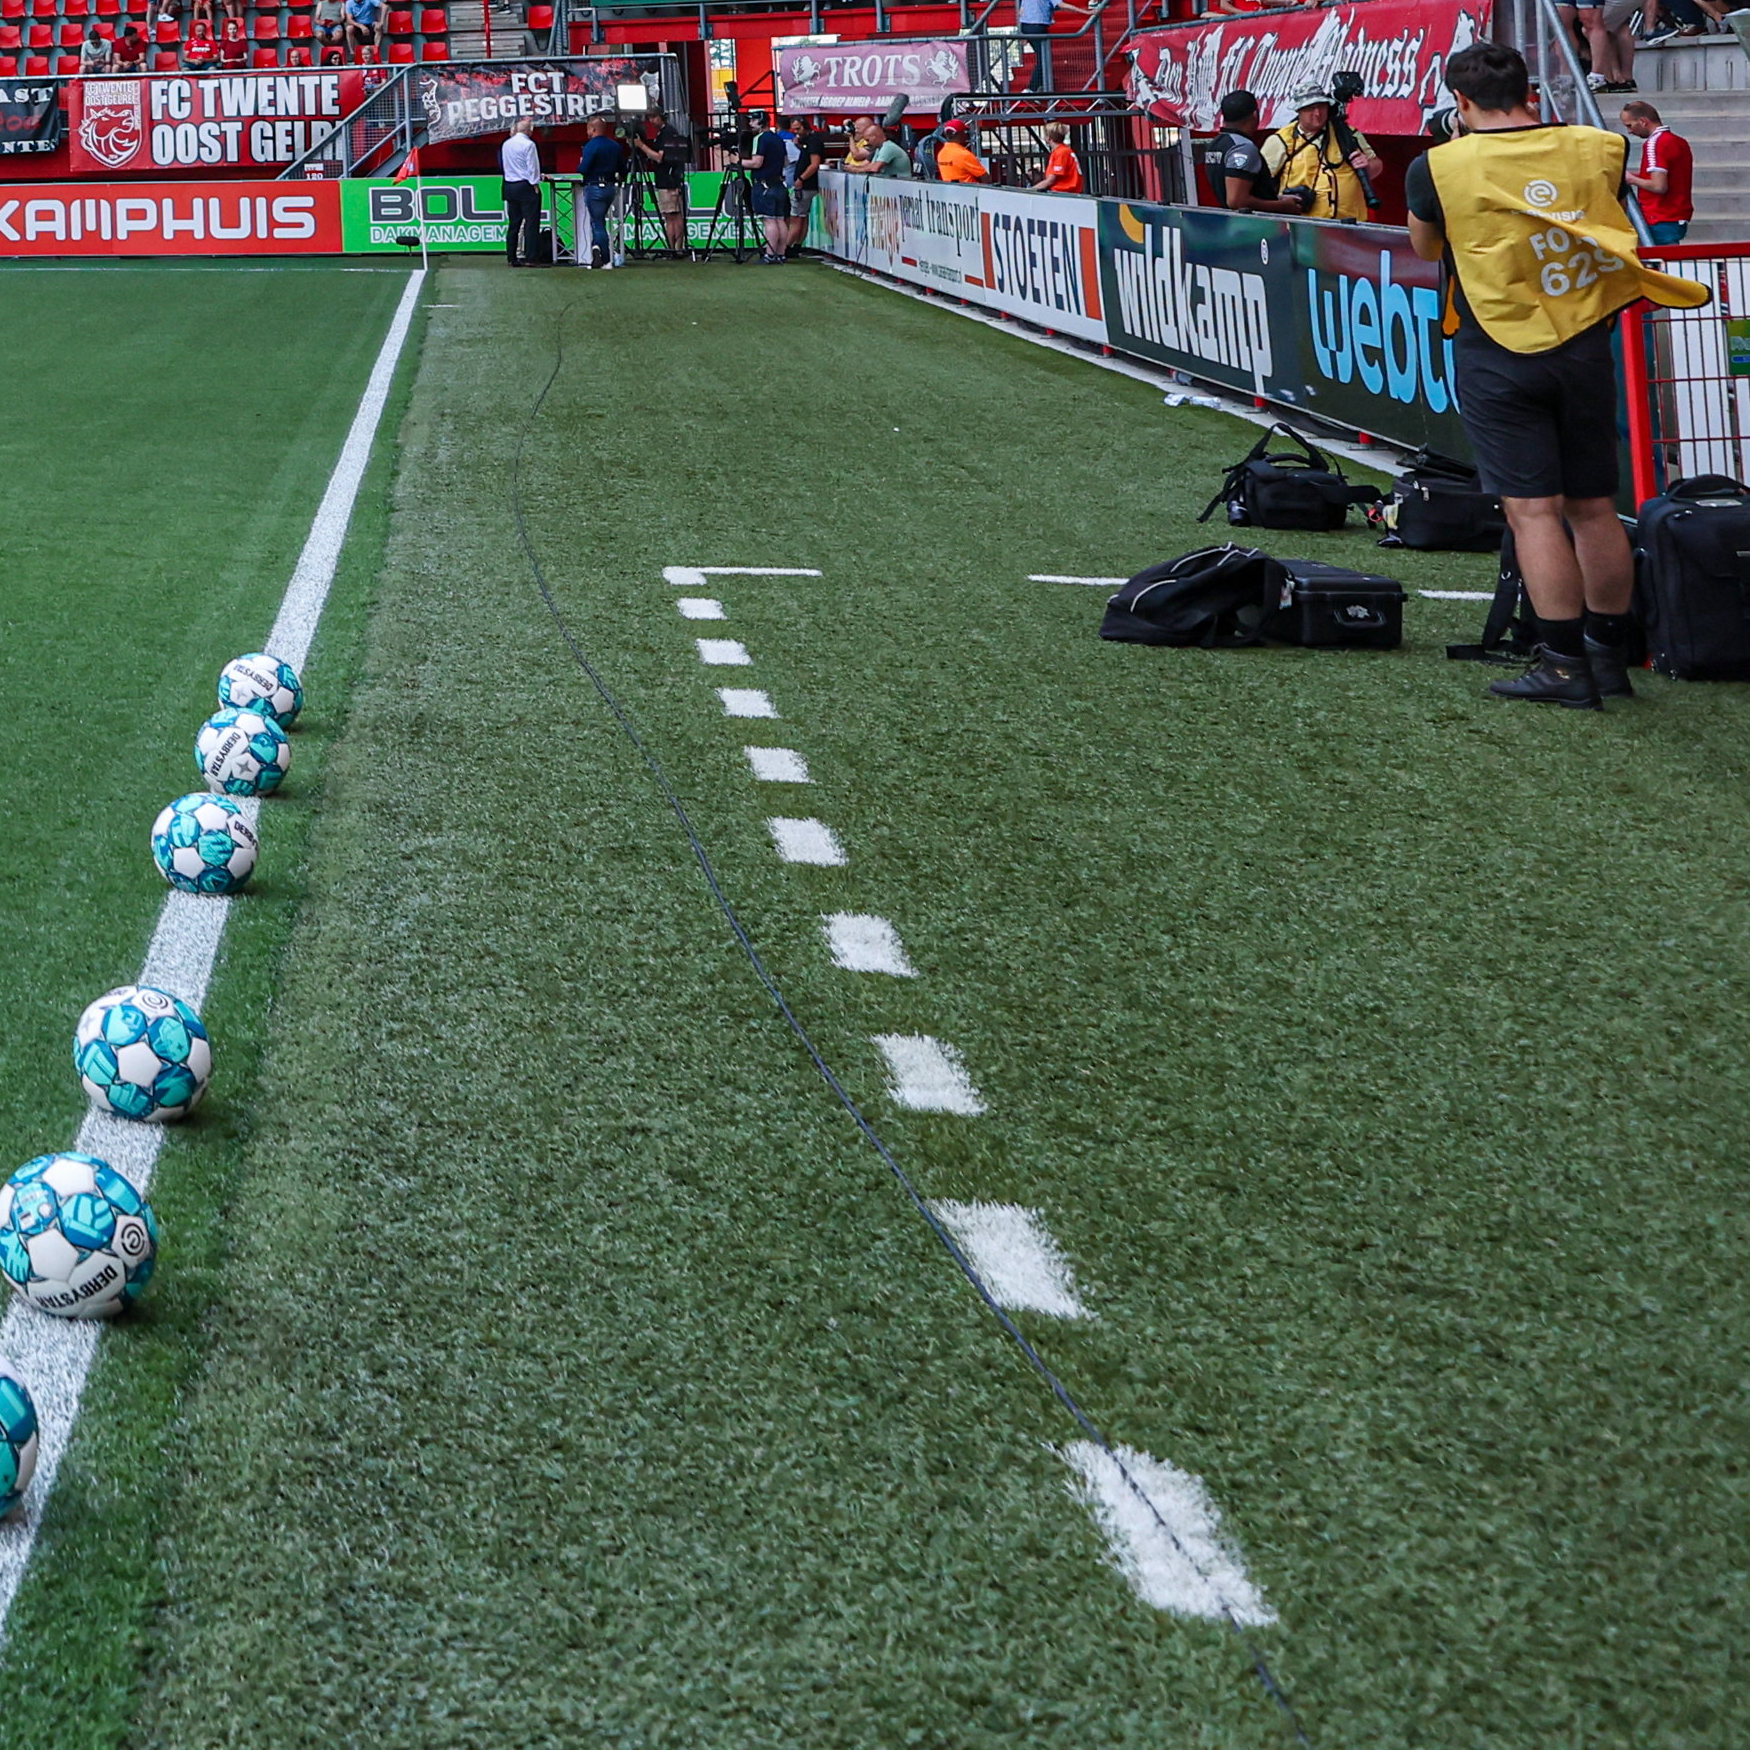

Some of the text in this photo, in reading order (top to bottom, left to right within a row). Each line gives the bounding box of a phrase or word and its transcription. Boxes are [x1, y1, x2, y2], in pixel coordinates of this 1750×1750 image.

[511, 71, 565, 95] FCT
[824, 53, 922, 88] TROTS
[150, 79, 193, 120] FC
[198, 74, 341, 118] TWENTE
[151, 121, 244, 166] OOST
[993, 211, 1081, 315] STOETEN
[1114, 223, 1273, 397] wildkamp
